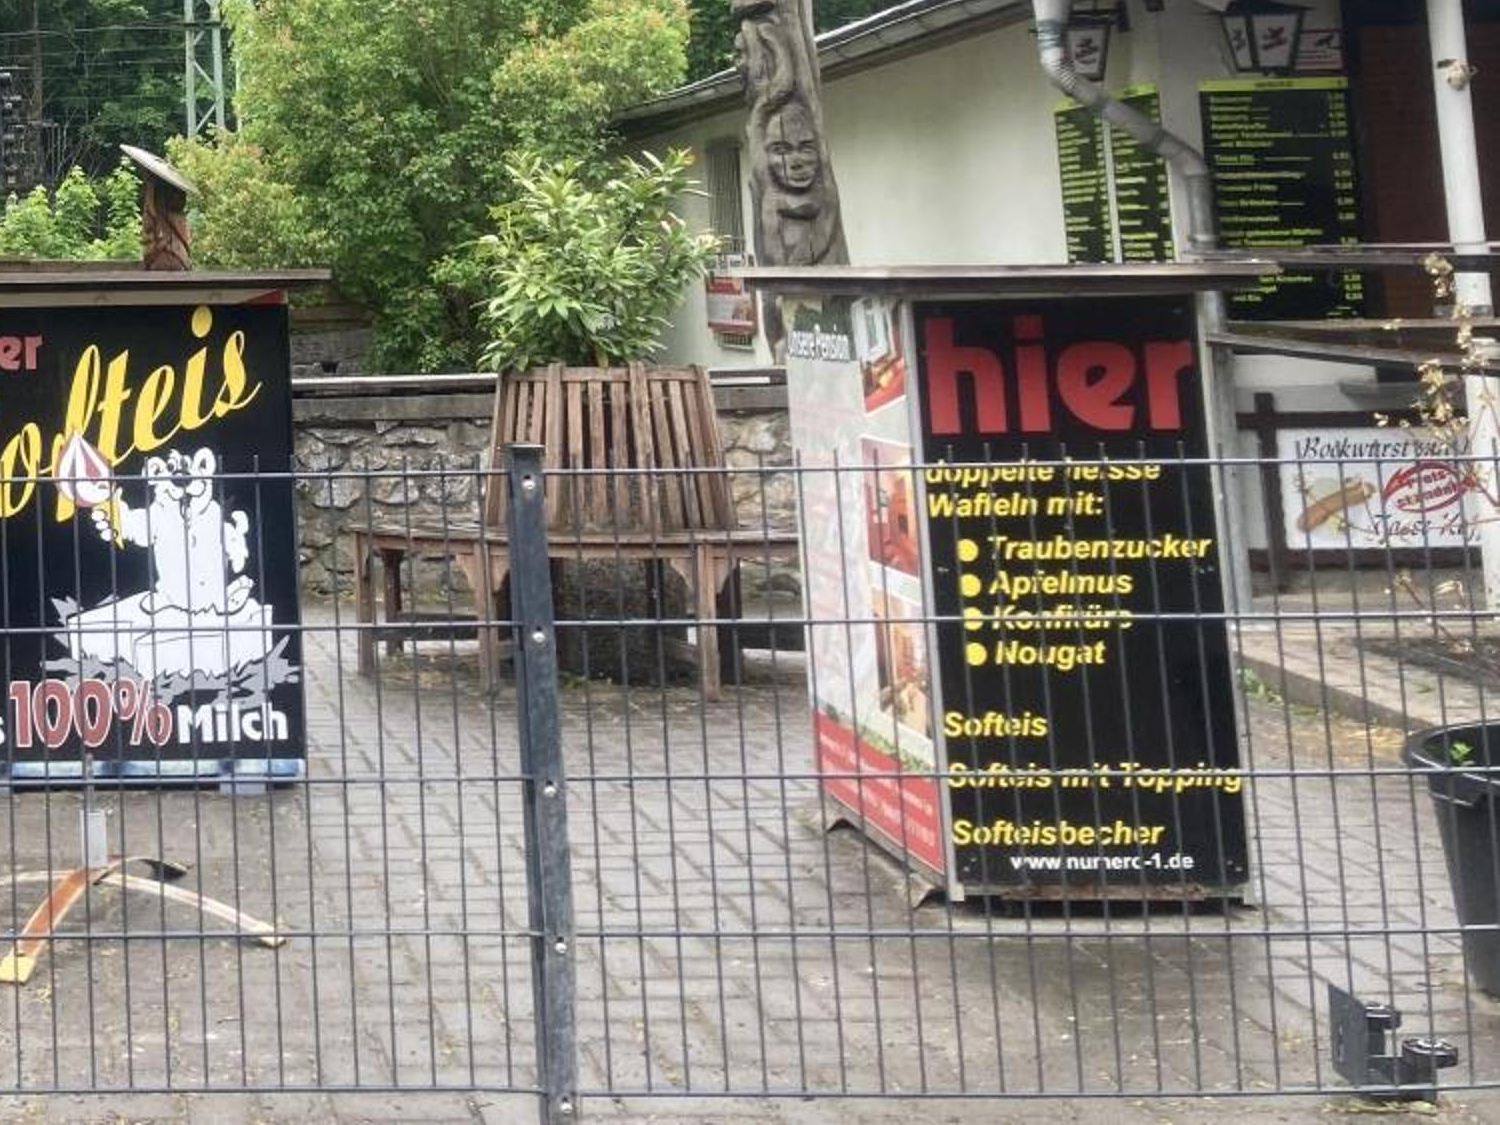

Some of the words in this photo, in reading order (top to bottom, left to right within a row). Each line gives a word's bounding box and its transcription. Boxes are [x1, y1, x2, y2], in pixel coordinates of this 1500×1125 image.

[924, 314, 1193, 436] hier
[1063, 456, 1162, 481] hesse
[927, 491, 1038, 518] Waffeln
[1046, 490, 1105, 516] mit:
[987, 533, 1213, 561] Traubenzucker
[988, 569, 1134, 600] Apfelmus
[994, 638, 1107, 672] Nougat
[9, 678, 173, 749] 100%
[178, 701, 290, 744] Milch
[944, 711, 1049, 738] Softeis
[948, 761, 1052, 789] Softeis
[1118, 760, 1244, 794] Topping
[951, 819, 1166, 847] Softeisbecher
[1009, 852, 1196, 871] wwwnumero-1.de
